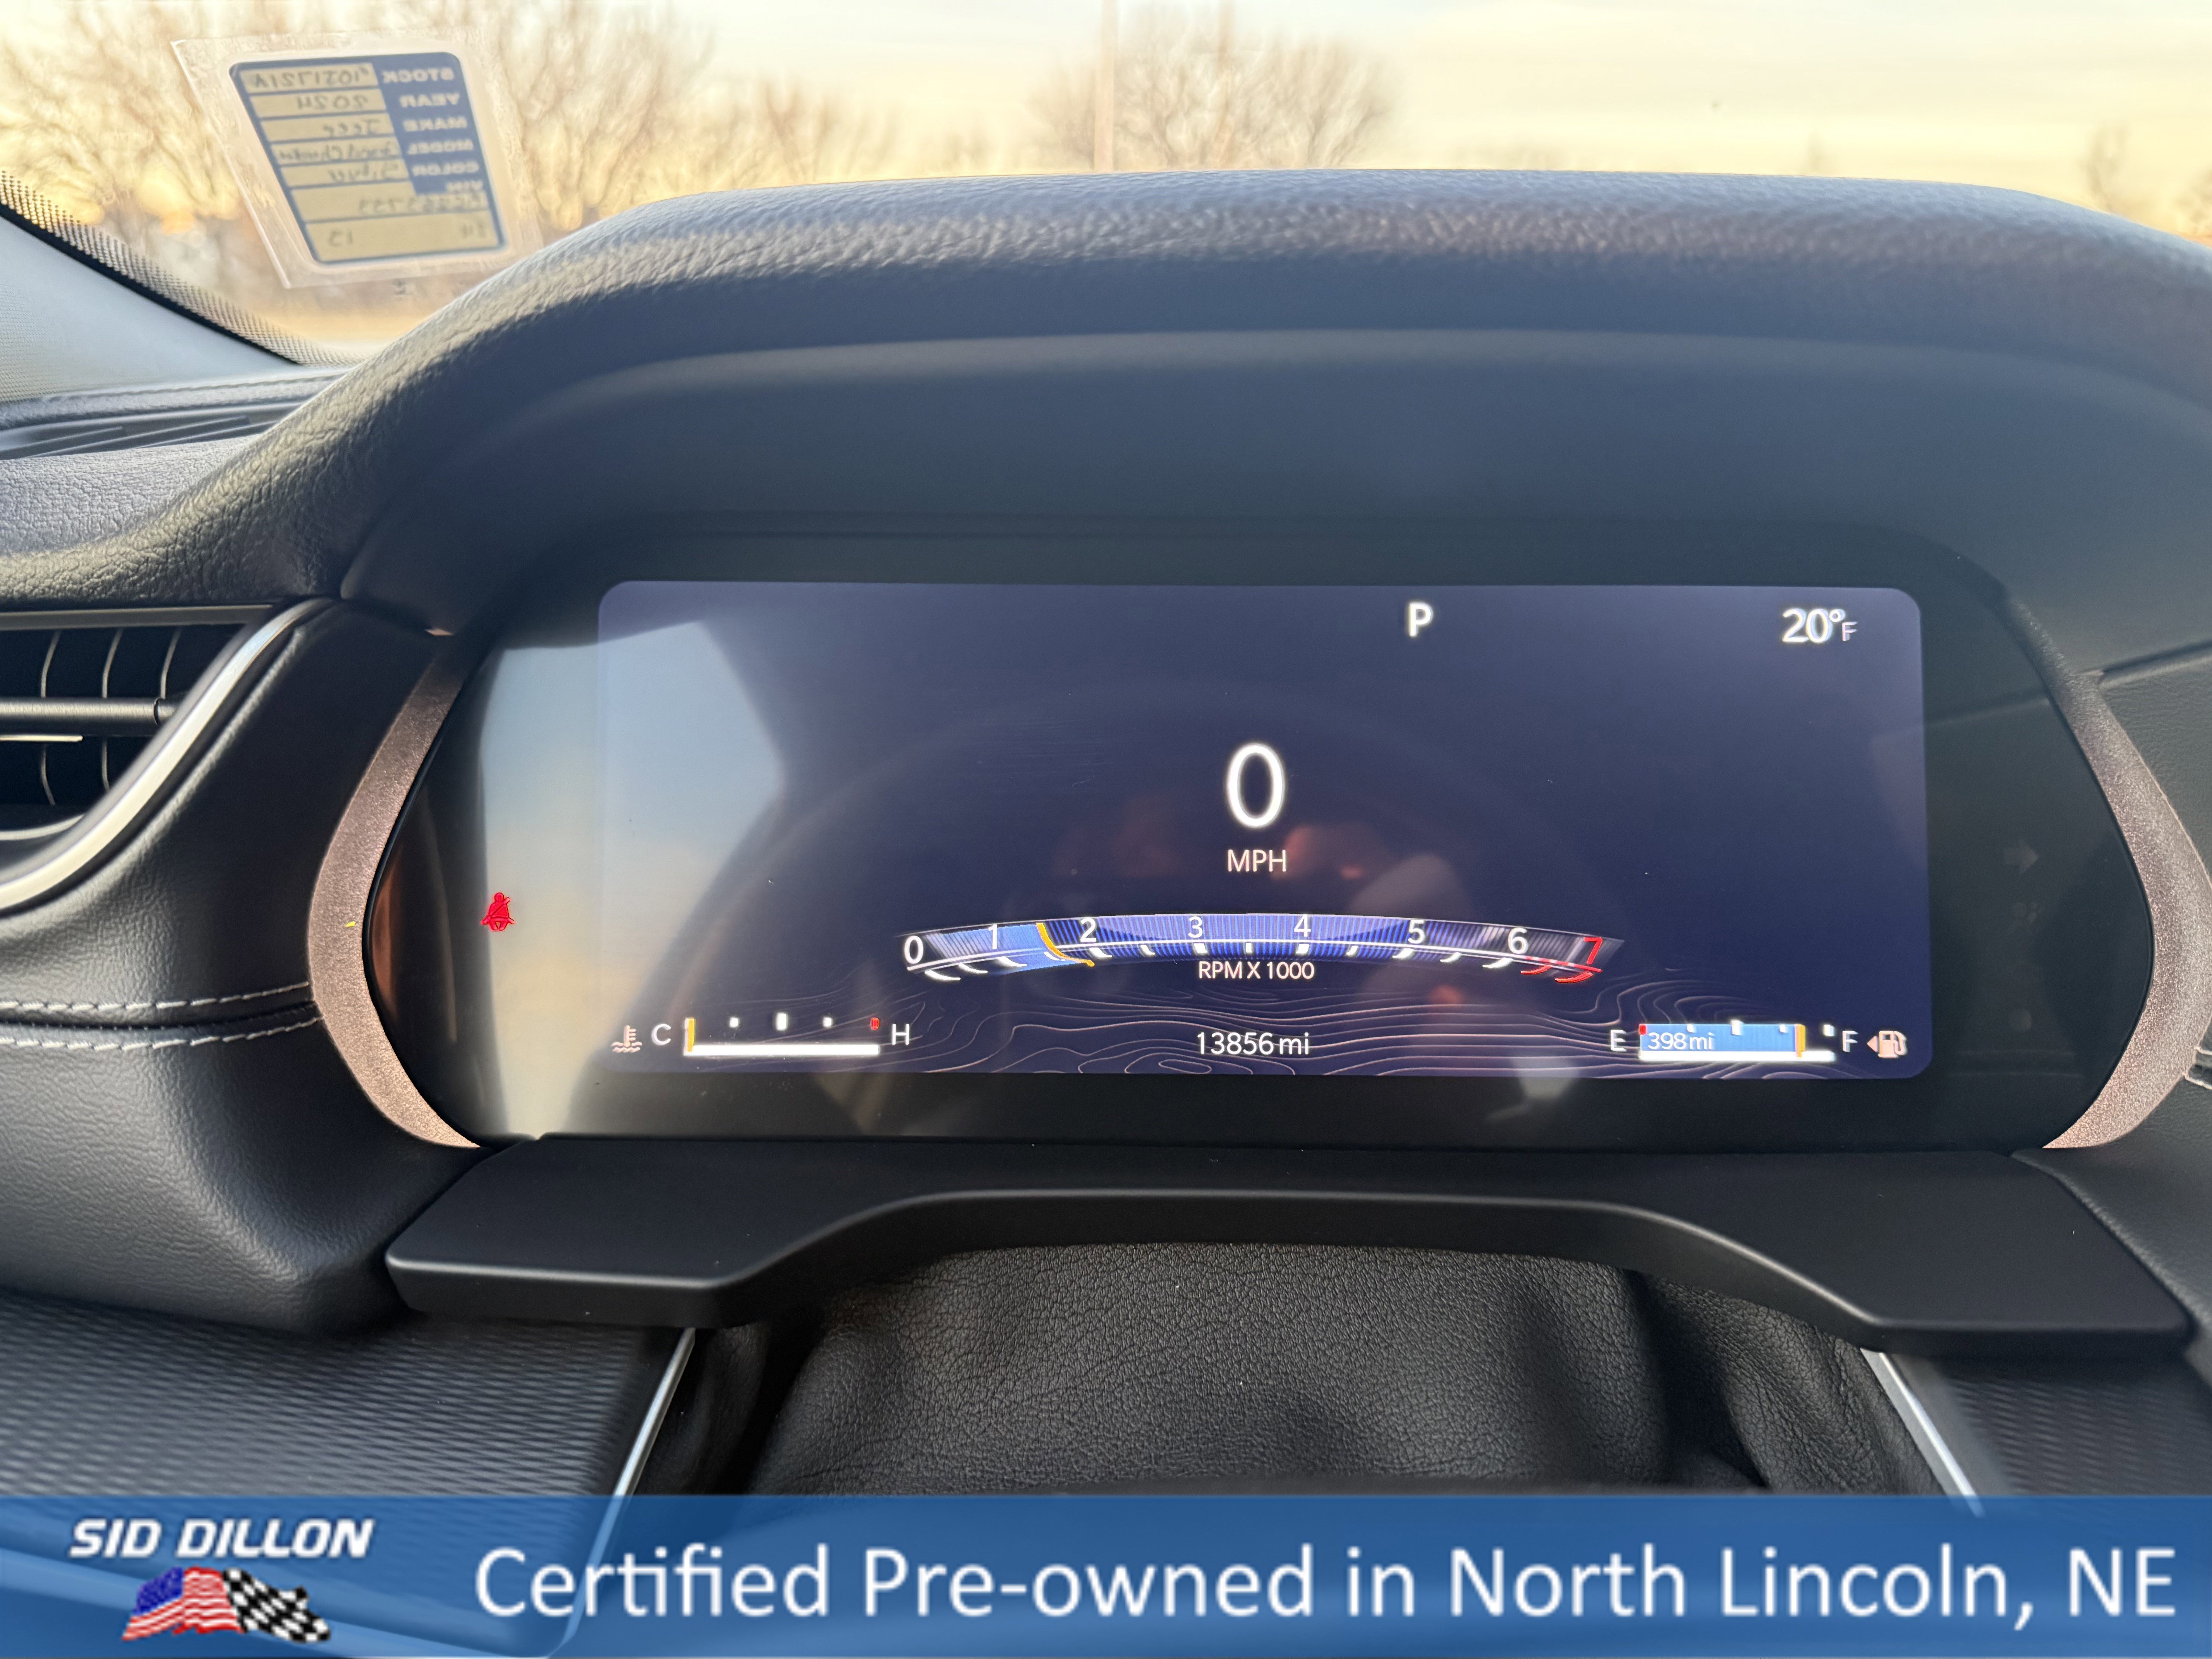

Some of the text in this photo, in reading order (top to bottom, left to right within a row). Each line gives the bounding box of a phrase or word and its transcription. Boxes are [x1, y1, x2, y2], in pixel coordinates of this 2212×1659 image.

[1408, 601, 1434, 637] P
[1226, 743, 1286, 828] 0
[1227, 849, 1287, 872] MPH
[904, 914, 1604, 965] 0 1 2 3 4 5 6 7
[1199, 961, 1315, 979] RPM X 1000
[651, 1022, 672, 1046] C
[891, 1023, 910, 1046] H
[1610, 1029, 1626, 1052] E
[1842, 1030, 1858, 1052] F
